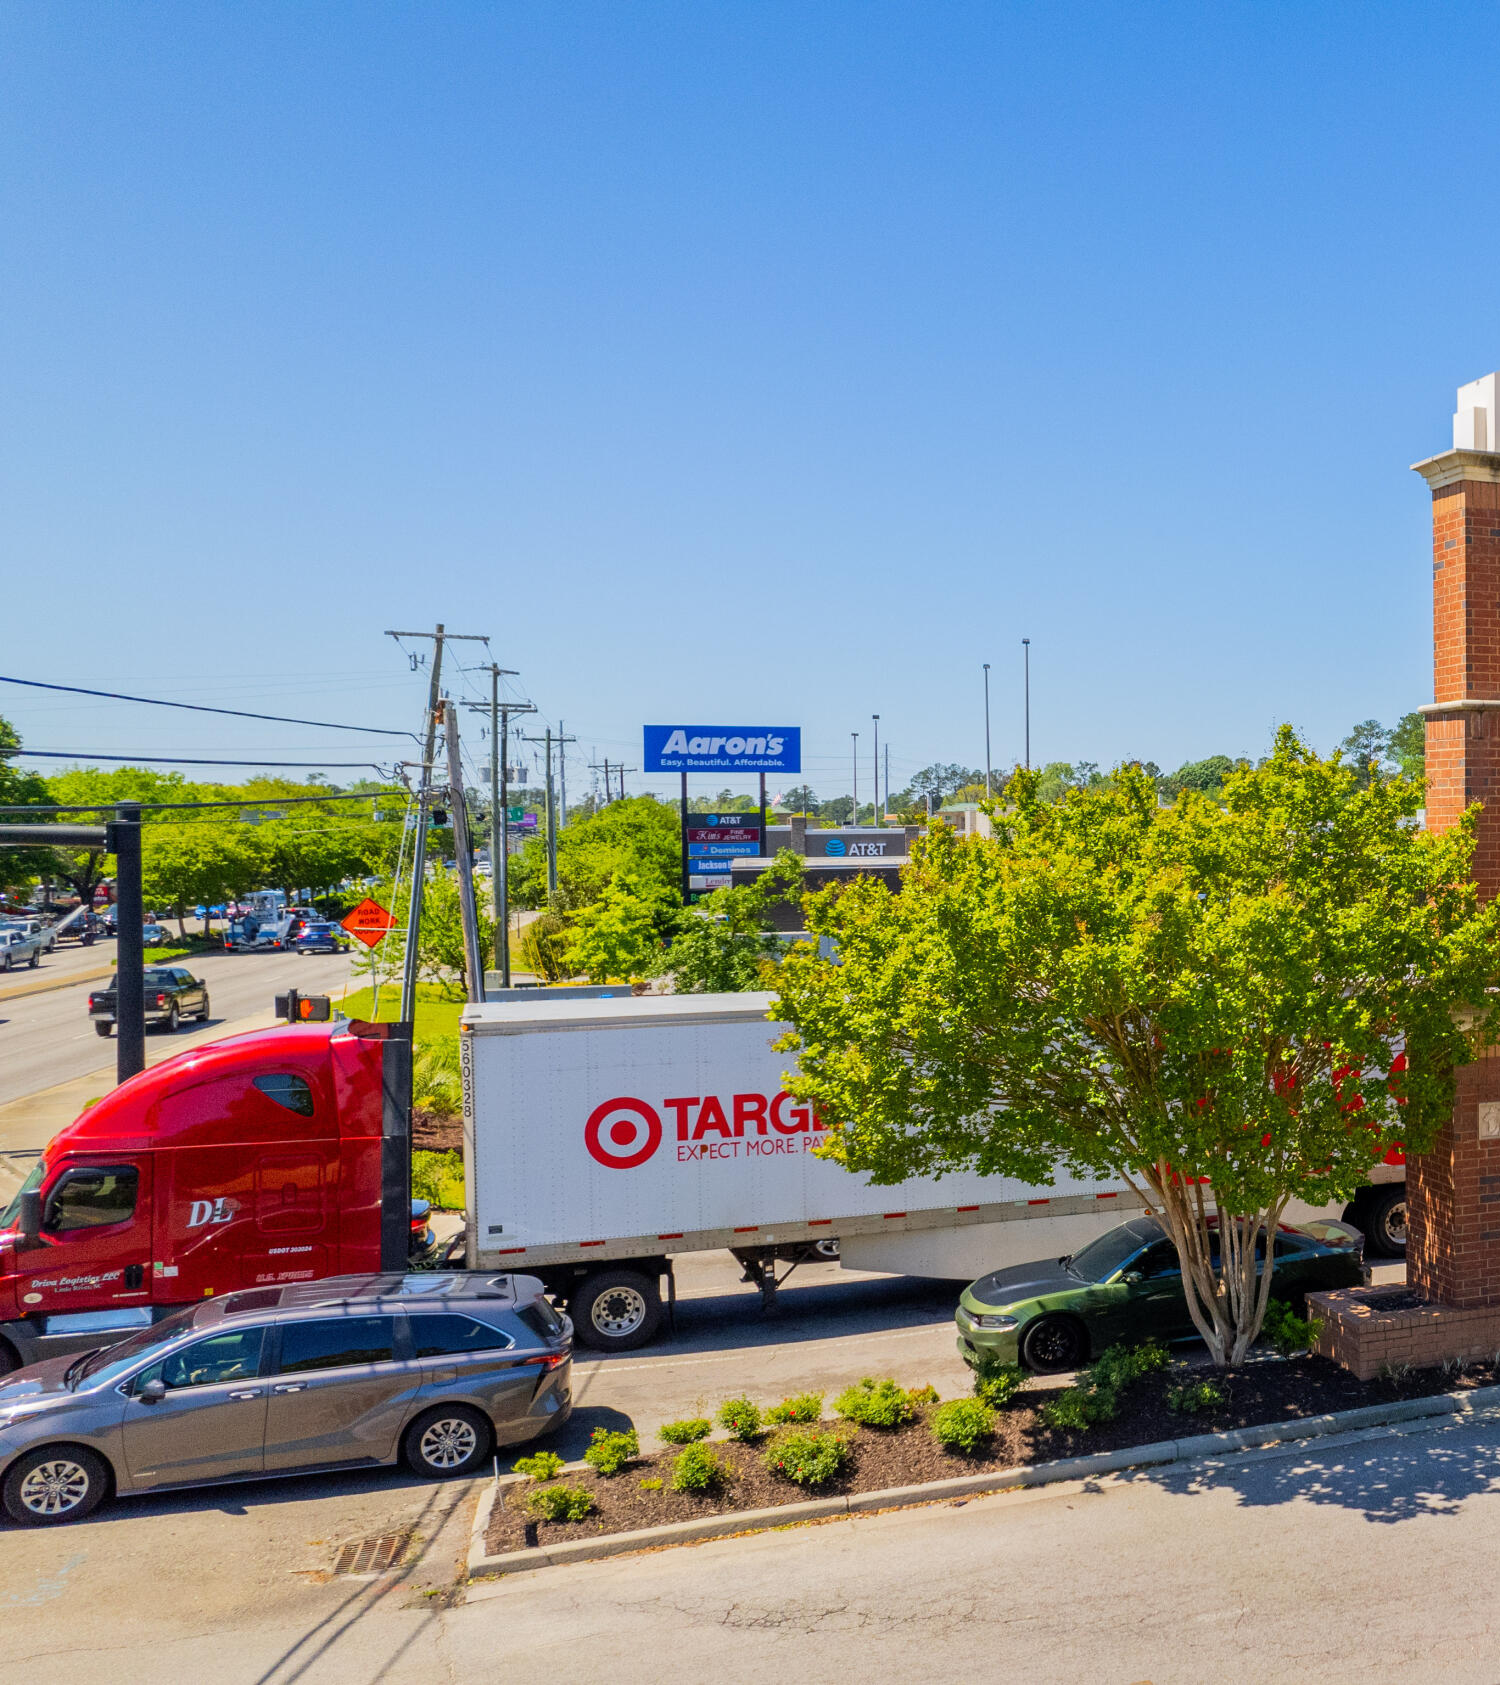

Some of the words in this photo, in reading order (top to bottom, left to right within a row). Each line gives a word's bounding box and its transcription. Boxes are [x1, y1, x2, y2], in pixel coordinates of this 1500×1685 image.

[661, 729, 784, 756] Aaron's
[660, 758, 684, 767] Easy.
[687, 758, 731, 767] Beautiful.
[734, 758, 785, 767] Affordable.
[719, 816, 742, 825] AT&T
[848, 842, 887, 857] AT&T
[698, 859, 728, 870] Jackson
[462, 1040, 472, 1117] 560328
[676, 1141, 741, 1162] EXPECT
[746, 1137, 799, 1157] MORE.
[803, 1134, 824, 1154] PA
[186, 1197, 233, 1228] DL
[59, 1276, 100, 1286] Logistics
